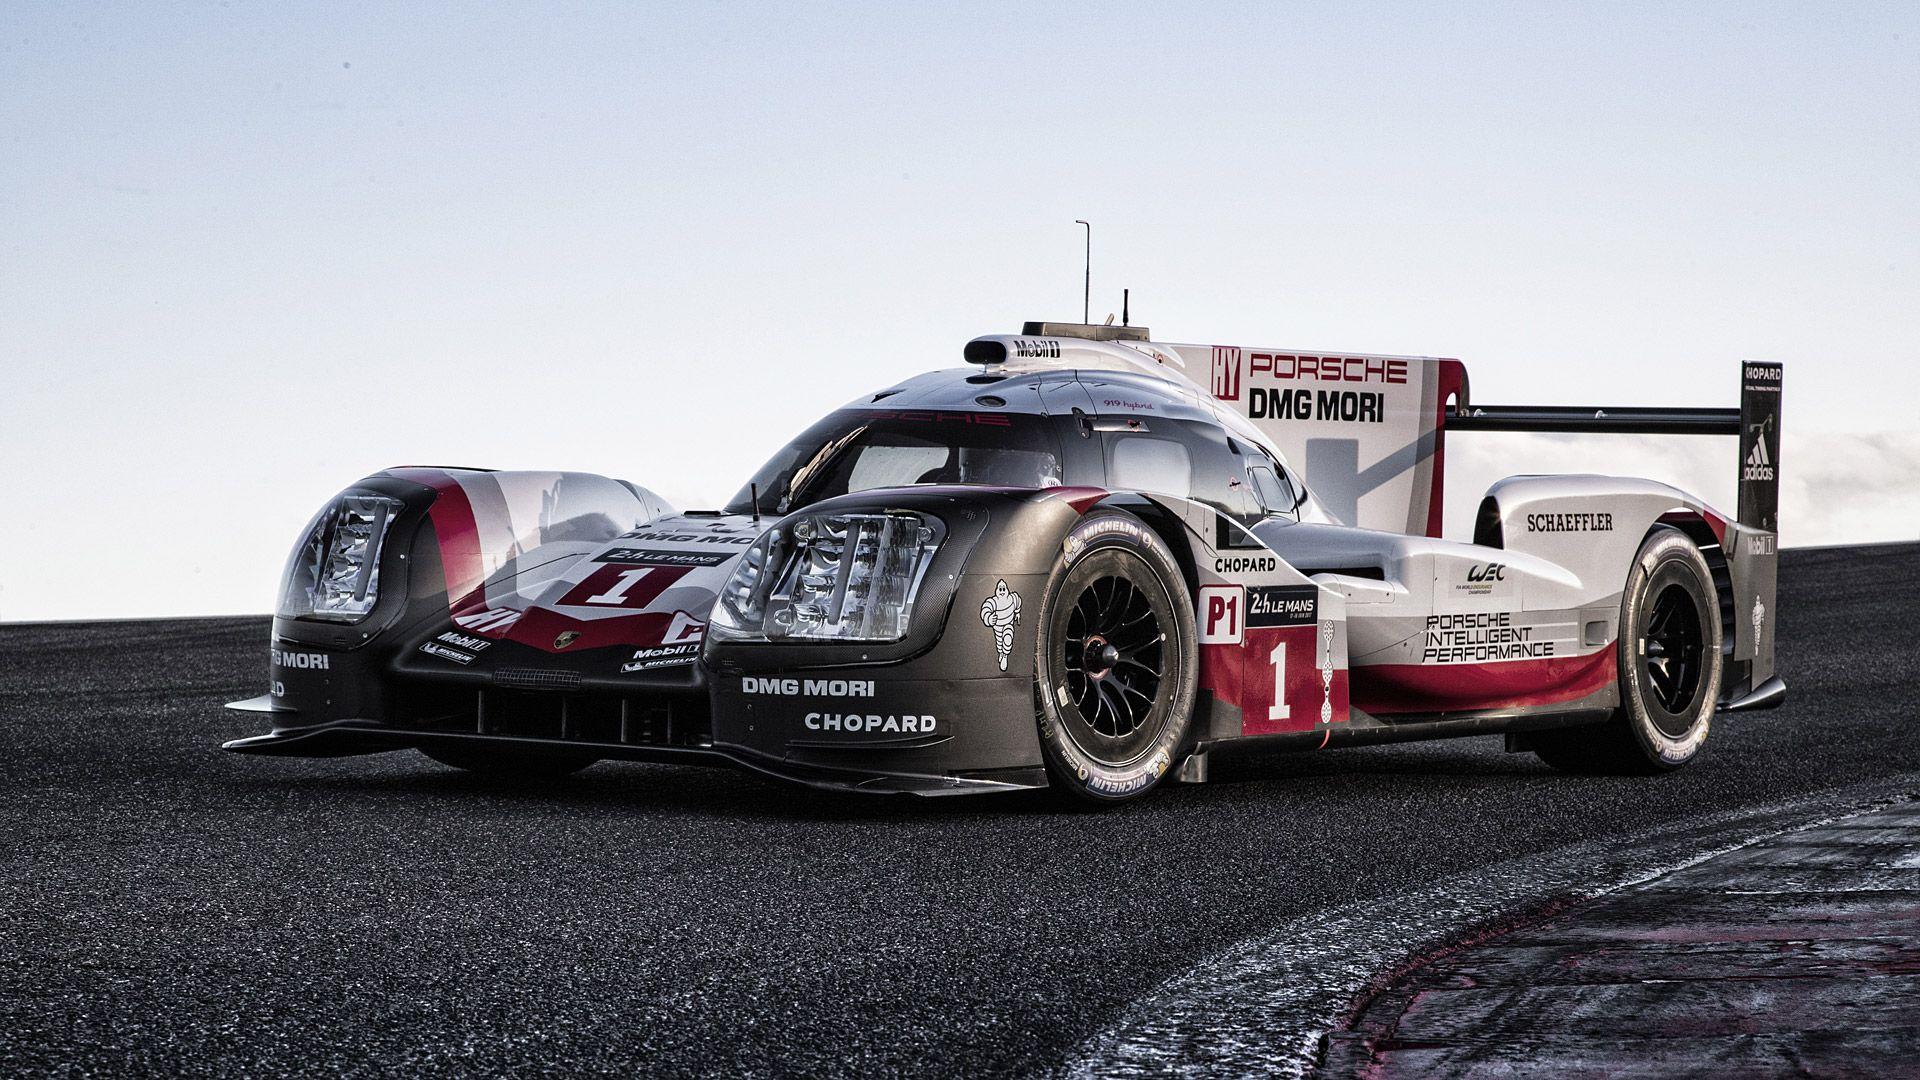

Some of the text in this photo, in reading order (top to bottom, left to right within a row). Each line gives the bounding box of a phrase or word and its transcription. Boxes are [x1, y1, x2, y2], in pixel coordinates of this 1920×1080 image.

[1014, 340, 1048, 358] Mobil
[1212, 346, 1240, 397] HY
[1250, 353, 1407, 384] PORSCHE
[1123, 400, 1154, 411] hybrid
[1249, 388, 1384, 423] DMG MORI
[1745, 464, 1773, 481] adidas
[1083, 520, 1139, 538] MICHELIN
[1527, 513, 1613, 532] SCHAEFFLER
[616, 532, 698, 542] DMG
[1748, 535, 1765, 555] Mobil
[1215, 557, 1276, 573] CHOPARD
[1467, 563, 1506, 582] WEC
[585, 568, 655, 604] 1
[1207, 596, 1237, 635] P1
[1272, 601, 1285, 613] LE
[1285, 600, 1314, 613] MANS
[1427, 612, 1510, 630] PORSCHE
[437, 632, 478, 648] Mobil
[1425, 627, 1532, 647] INTELLIGENT
[283, 651, 329, 669] MORI
[633, 646, 686, 659] Mobil
[645, 656, 699, 667] MICHELIN
[1422, 642, 1553, 663] PERFORMANCE
[742, 677, 875, 697] DMG MORI
[1268, 642, 1290, 720] 1
[804, 712, 937, 732] CHOPARD
[1091, 774, 1147, 793] MICHELIN
